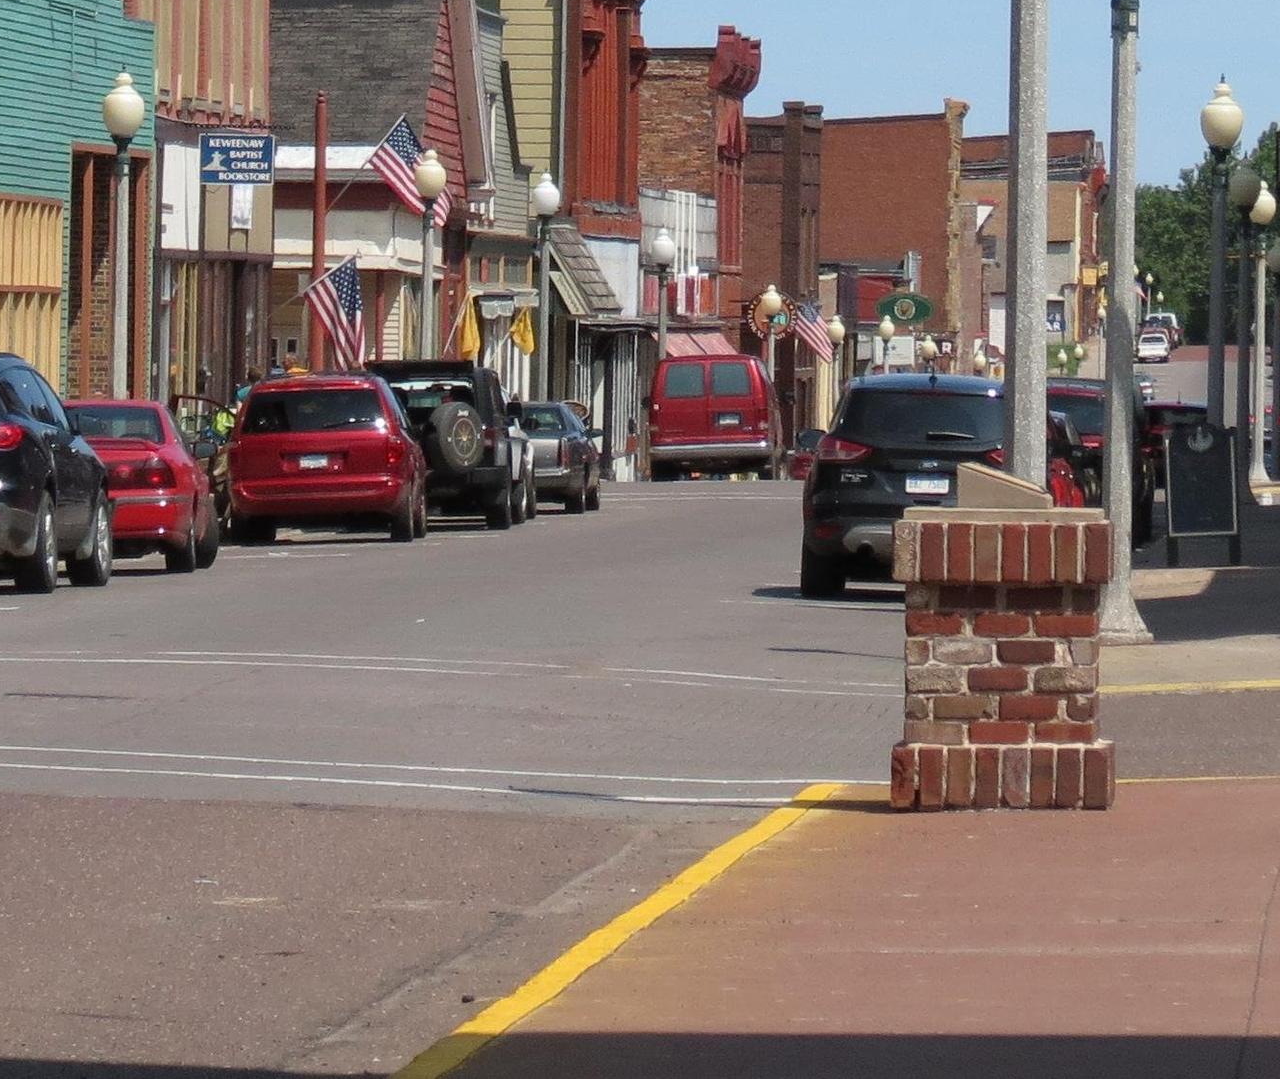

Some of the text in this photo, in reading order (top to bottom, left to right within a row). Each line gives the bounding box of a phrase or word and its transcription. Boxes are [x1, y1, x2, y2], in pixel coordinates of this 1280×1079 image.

[208, 138, 265, 148] KEWEENAW
[229, 150, 263, 159] BAPTIST
[230, 161, 269, 170] CHURCH
[218, 172, 271, 181] BOOKSTORE
